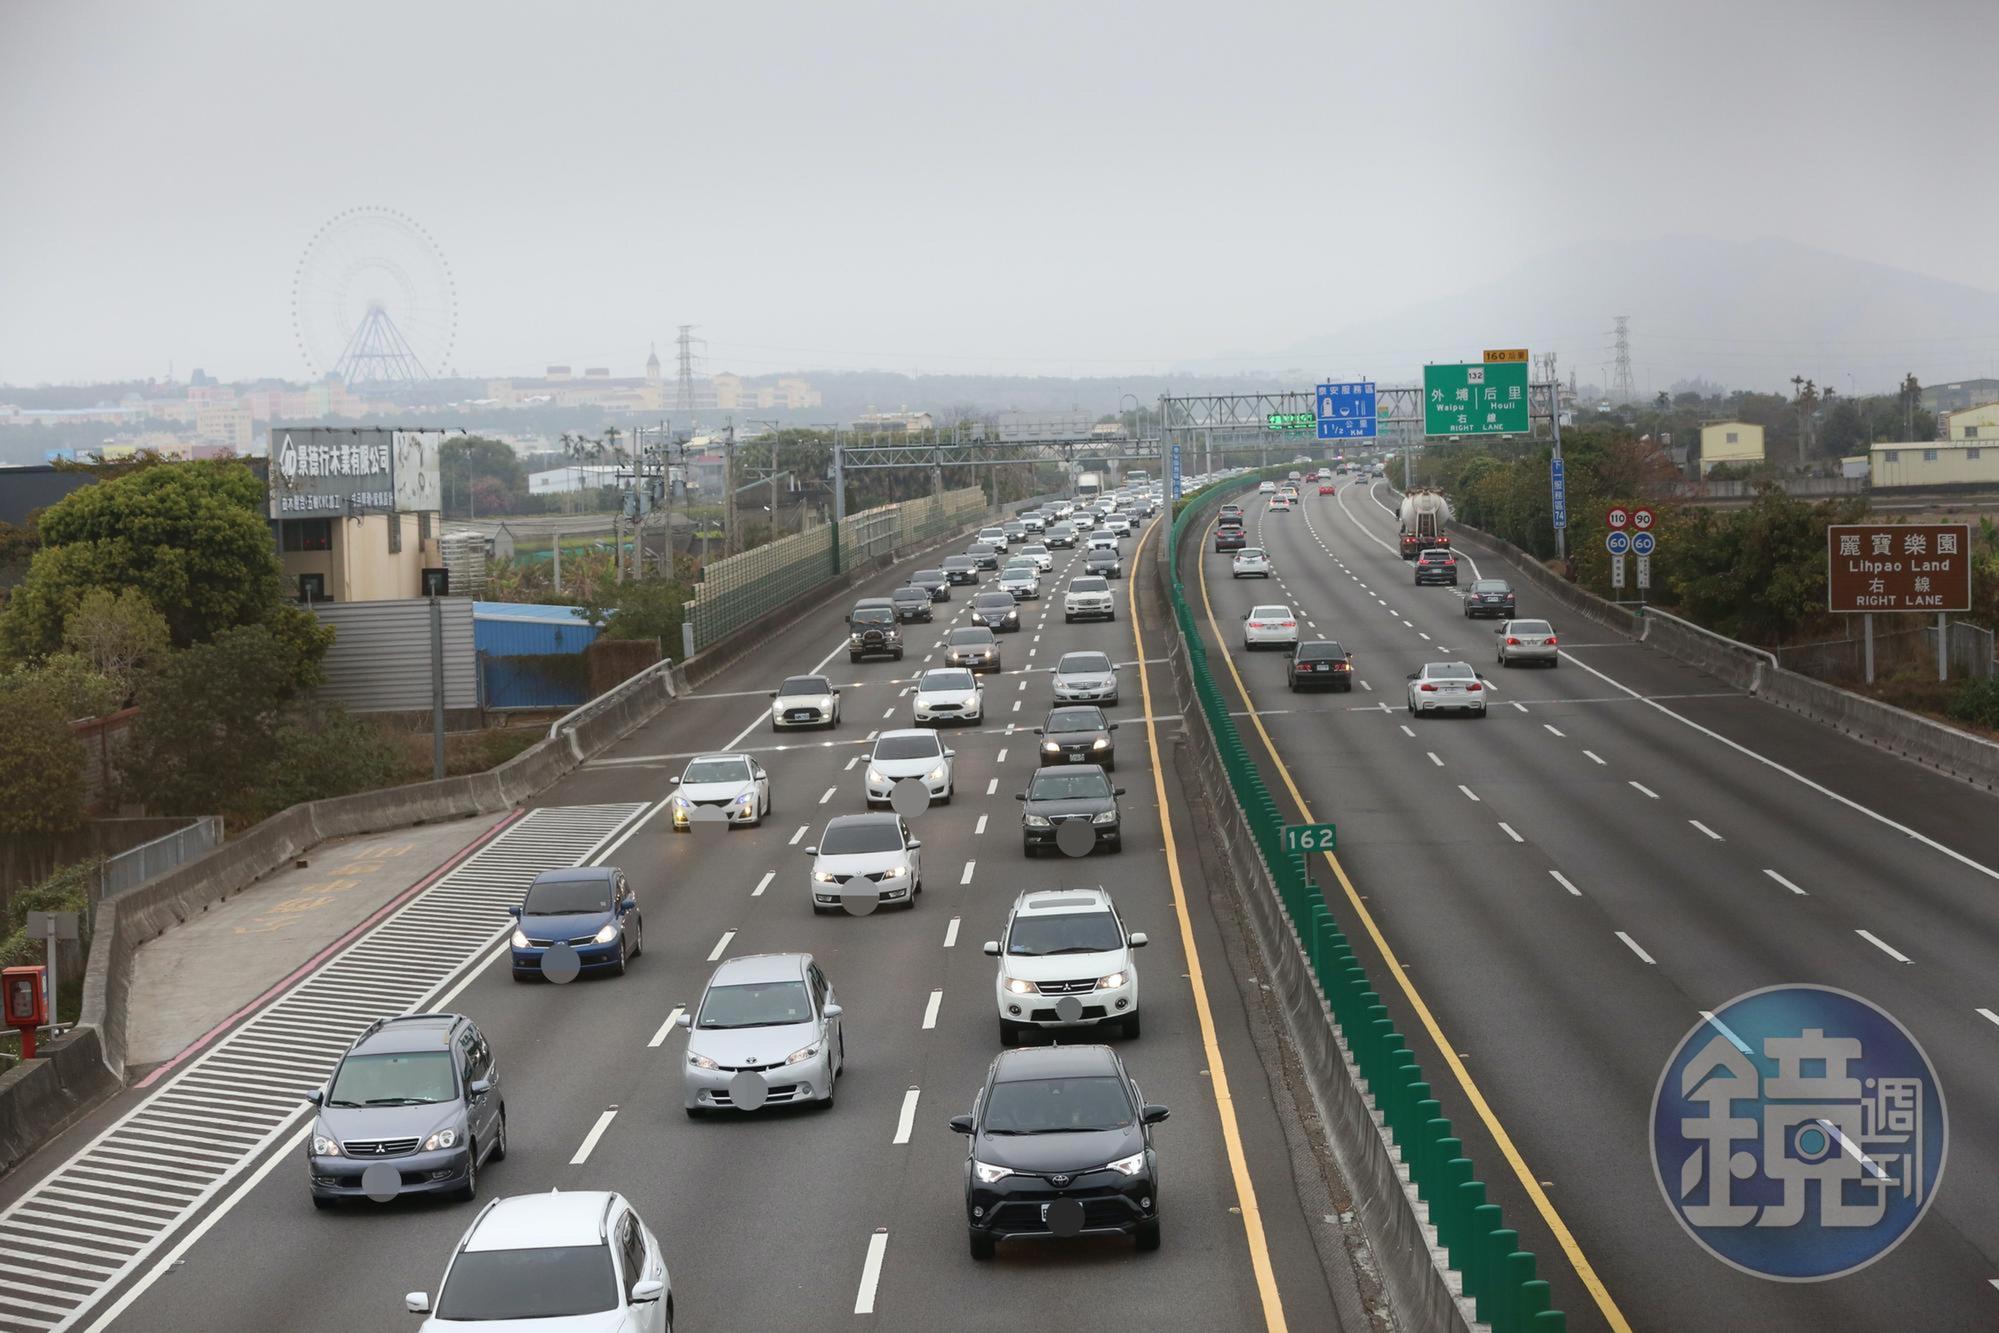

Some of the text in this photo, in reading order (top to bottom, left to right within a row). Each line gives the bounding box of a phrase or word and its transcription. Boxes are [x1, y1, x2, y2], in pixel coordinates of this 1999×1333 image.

[1487, 352, 1505, 360] 160
[1469, 372, 1483, 380] 132
[1431, 387, 1469, 402] 外埔
[1484, 386, 1522, 400] 后里
[1436, 404, 1464, 412] Waipu
[1490, 402, 1515, 410] Houli
[1482, 423, 1504, 431] LANE
[1554, 511, 1564, 520] 74
[1611, 514, 1626, 523] 110
[1636, 514, 1651, 524] 90
[1610, 538, 1627, 548] 60
[1635, 539, 1652, 548] 60
[1839, 533, 1958, 556] 麗寶樂園
[1850, 559, 1950, 574] Lihpao Land
[1868, 575, 1931, 593] 右線
[1856, 594, 1943, 606] RIGHT LANE
[1289, 829, 1334, 849] 162
